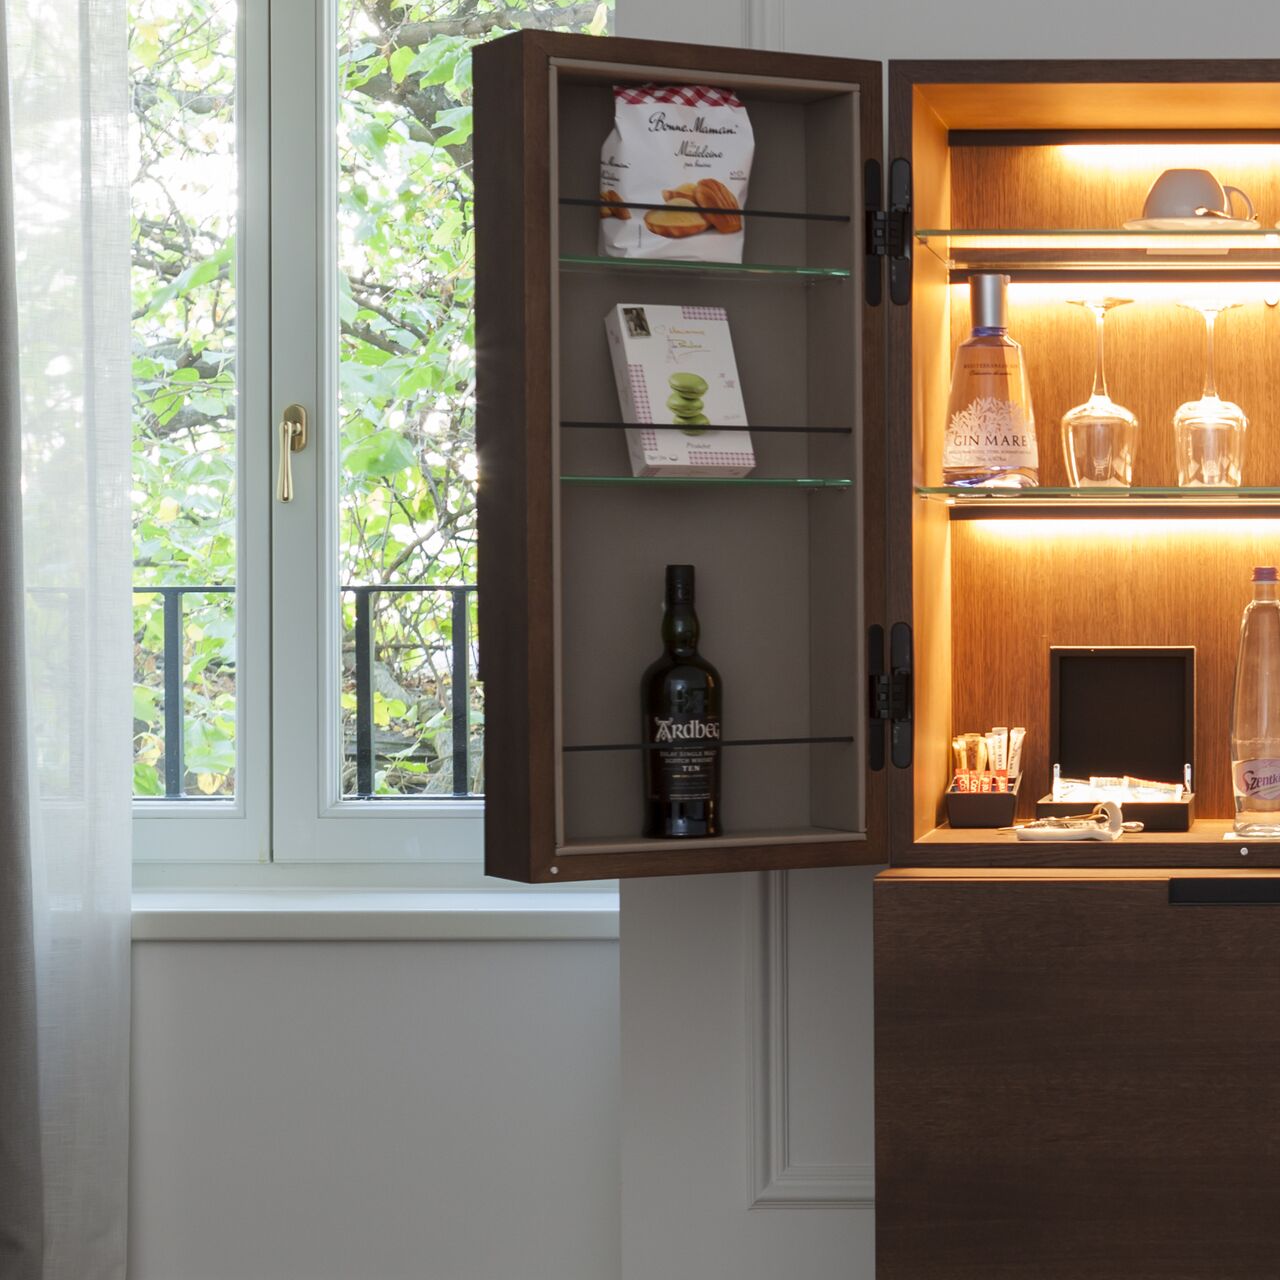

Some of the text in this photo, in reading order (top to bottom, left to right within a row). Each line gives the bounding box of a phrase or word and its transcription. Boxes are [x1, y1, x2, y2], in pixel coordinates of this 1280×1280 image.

[953, 434, 1027, 447] GIN MARE
[655, 717, 720, 743] Ardbeg
